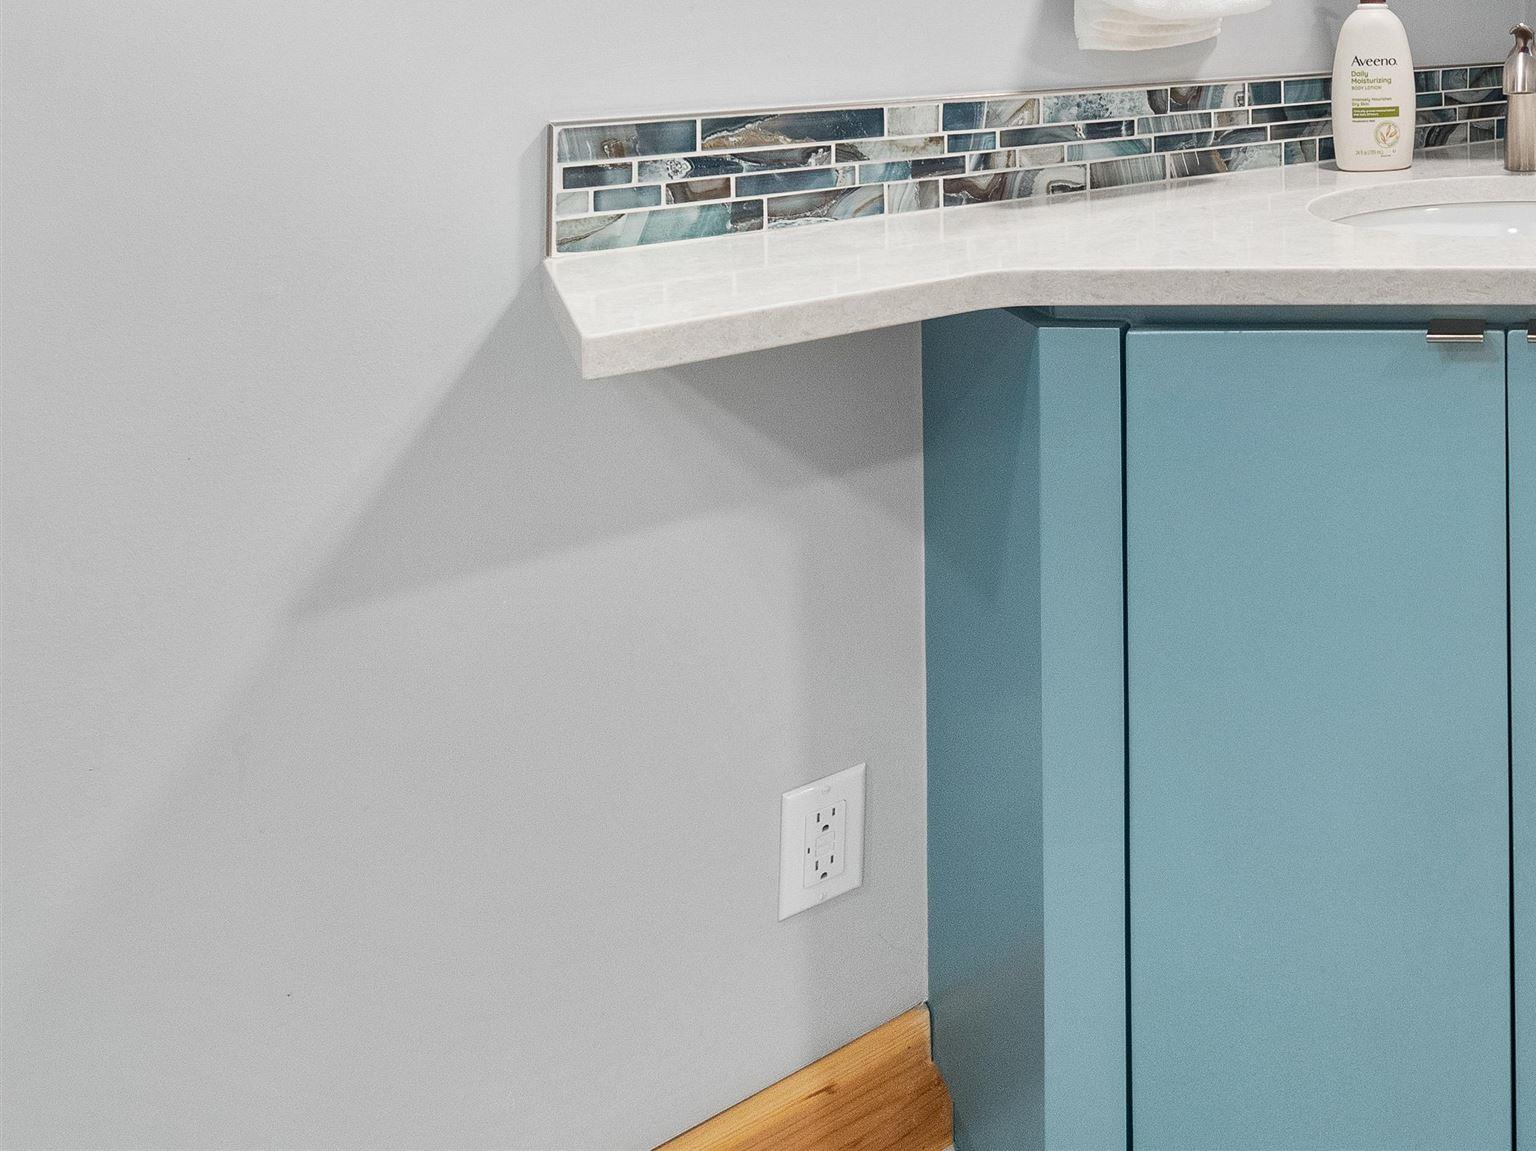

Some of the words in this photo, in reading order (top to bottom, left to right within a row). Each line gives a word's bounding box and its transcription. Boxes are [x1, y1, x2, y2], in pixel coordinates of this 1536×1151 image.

[1351, 56, 1396, 66] Aveeno
[1351, 70, 1369, 78] Daily
[1351, 77, 1392, 85] Moisturizing
